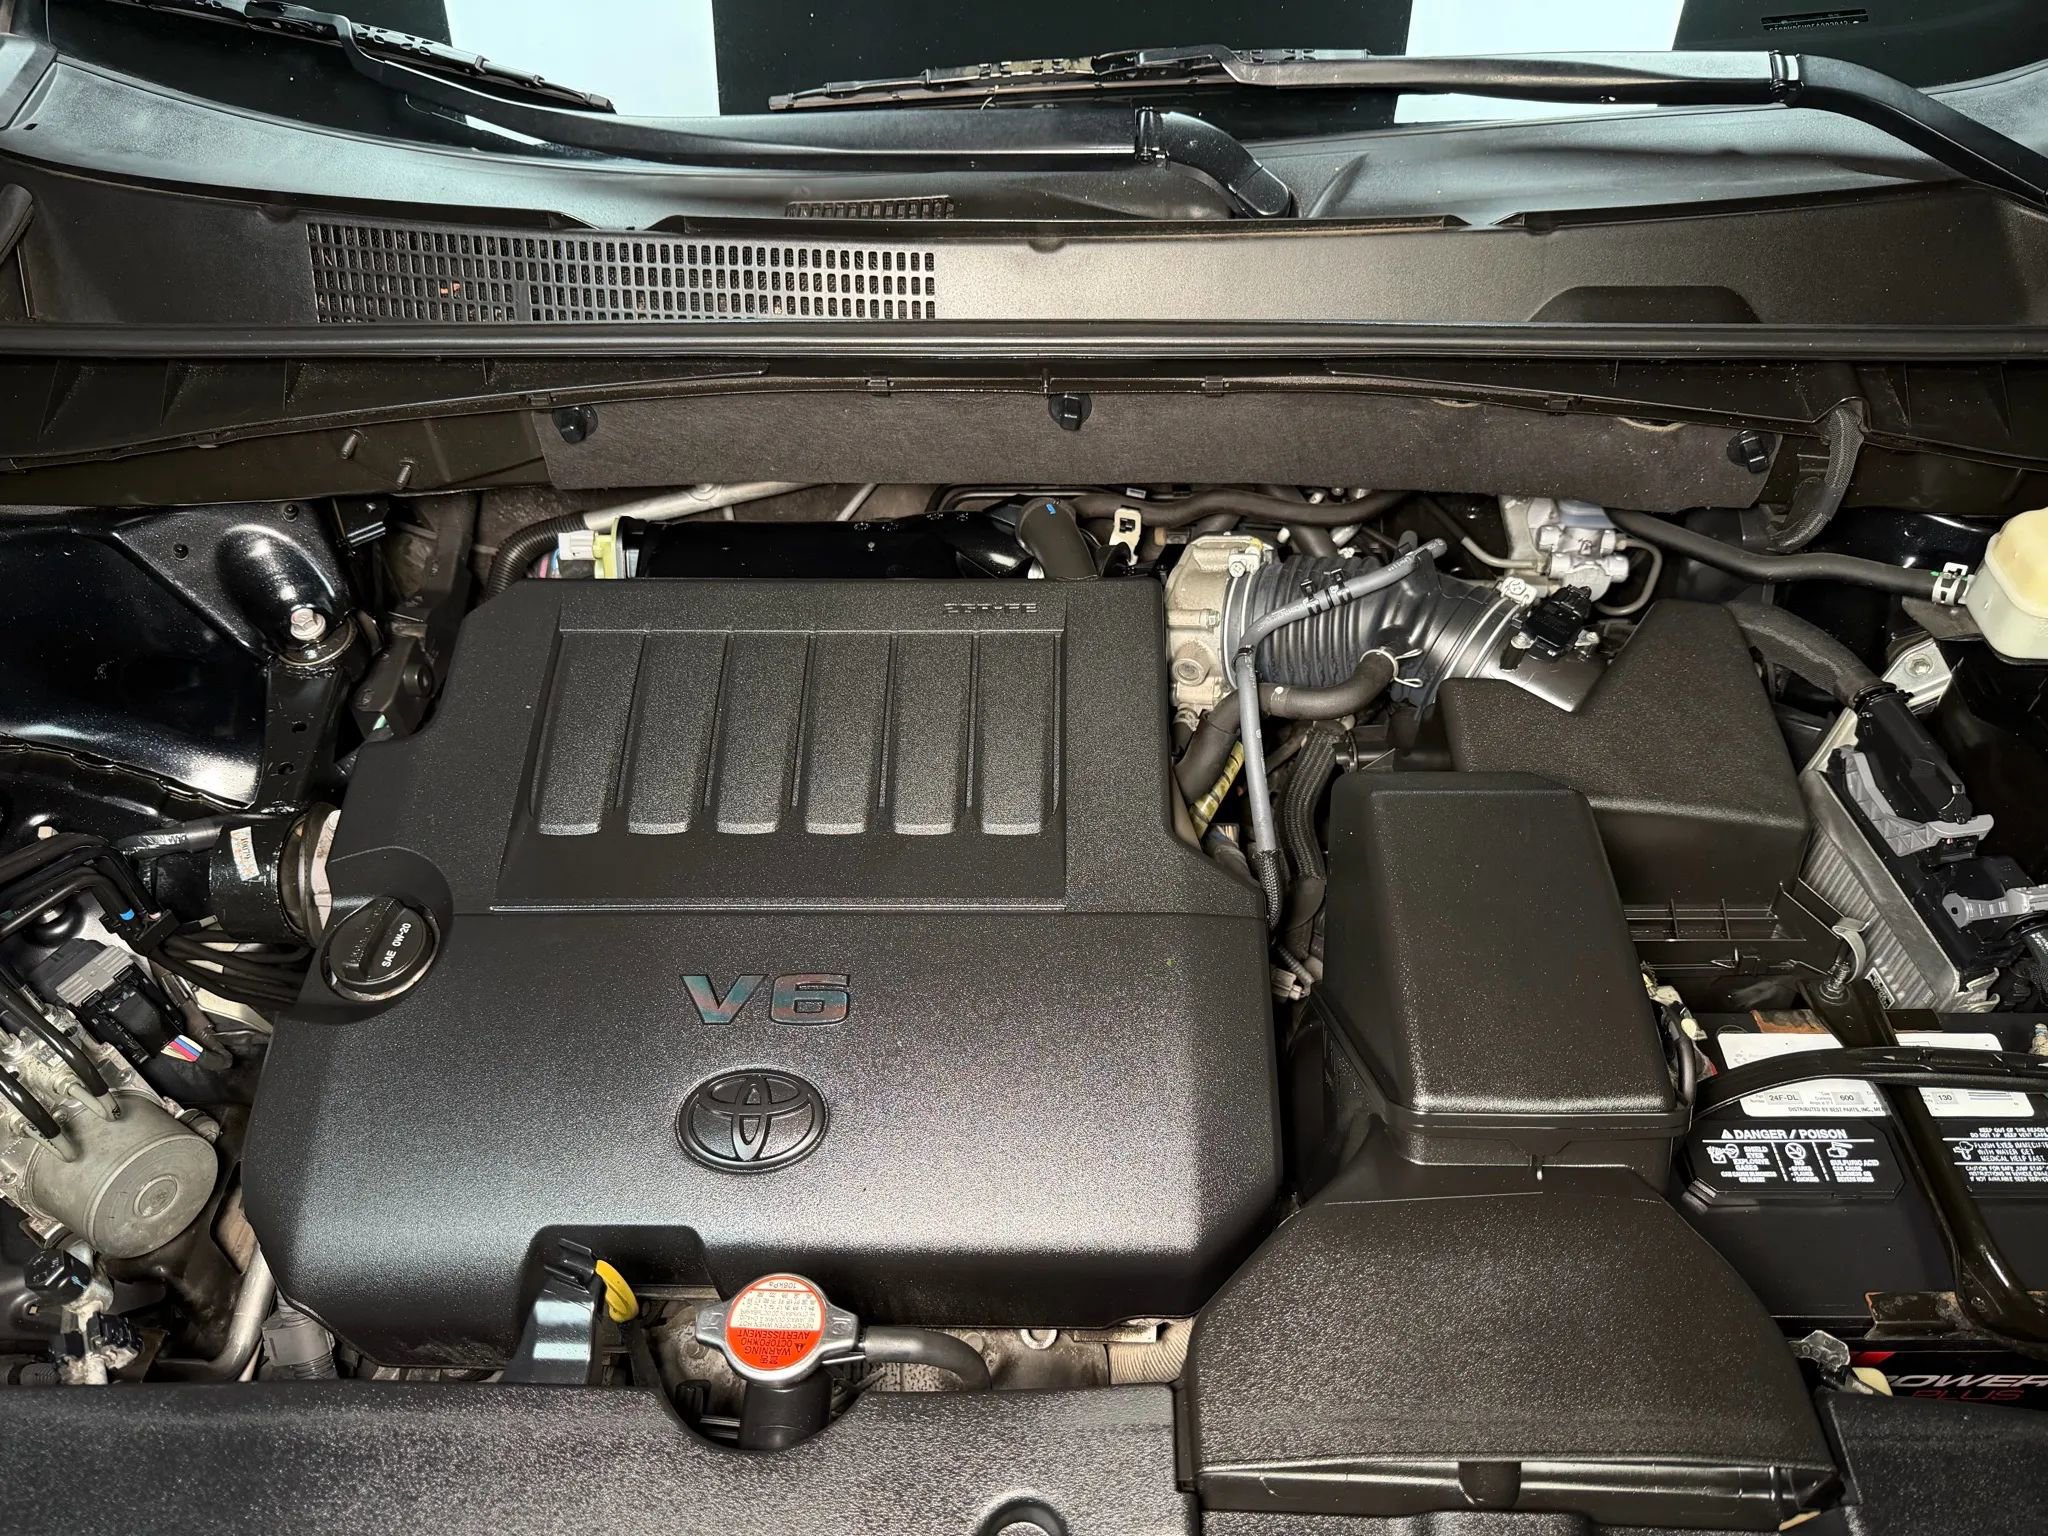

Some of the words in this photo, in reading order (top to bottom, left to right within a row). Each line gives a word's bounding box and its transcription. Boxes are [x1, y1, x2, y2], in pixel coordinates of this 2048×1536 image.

[381, 950, 396, 968] SAE
[392, 922, 412, 947] 0W-20
[680, 973, 850, 1026] V6
[1733, 1129, 1788, 1139] DANGER
[1798, 1129, 1848, 1139] POISON
[737, 1329, 810, 1340] AVERTISSEMENT
[744, 1346, 791, 1356] WARNING
